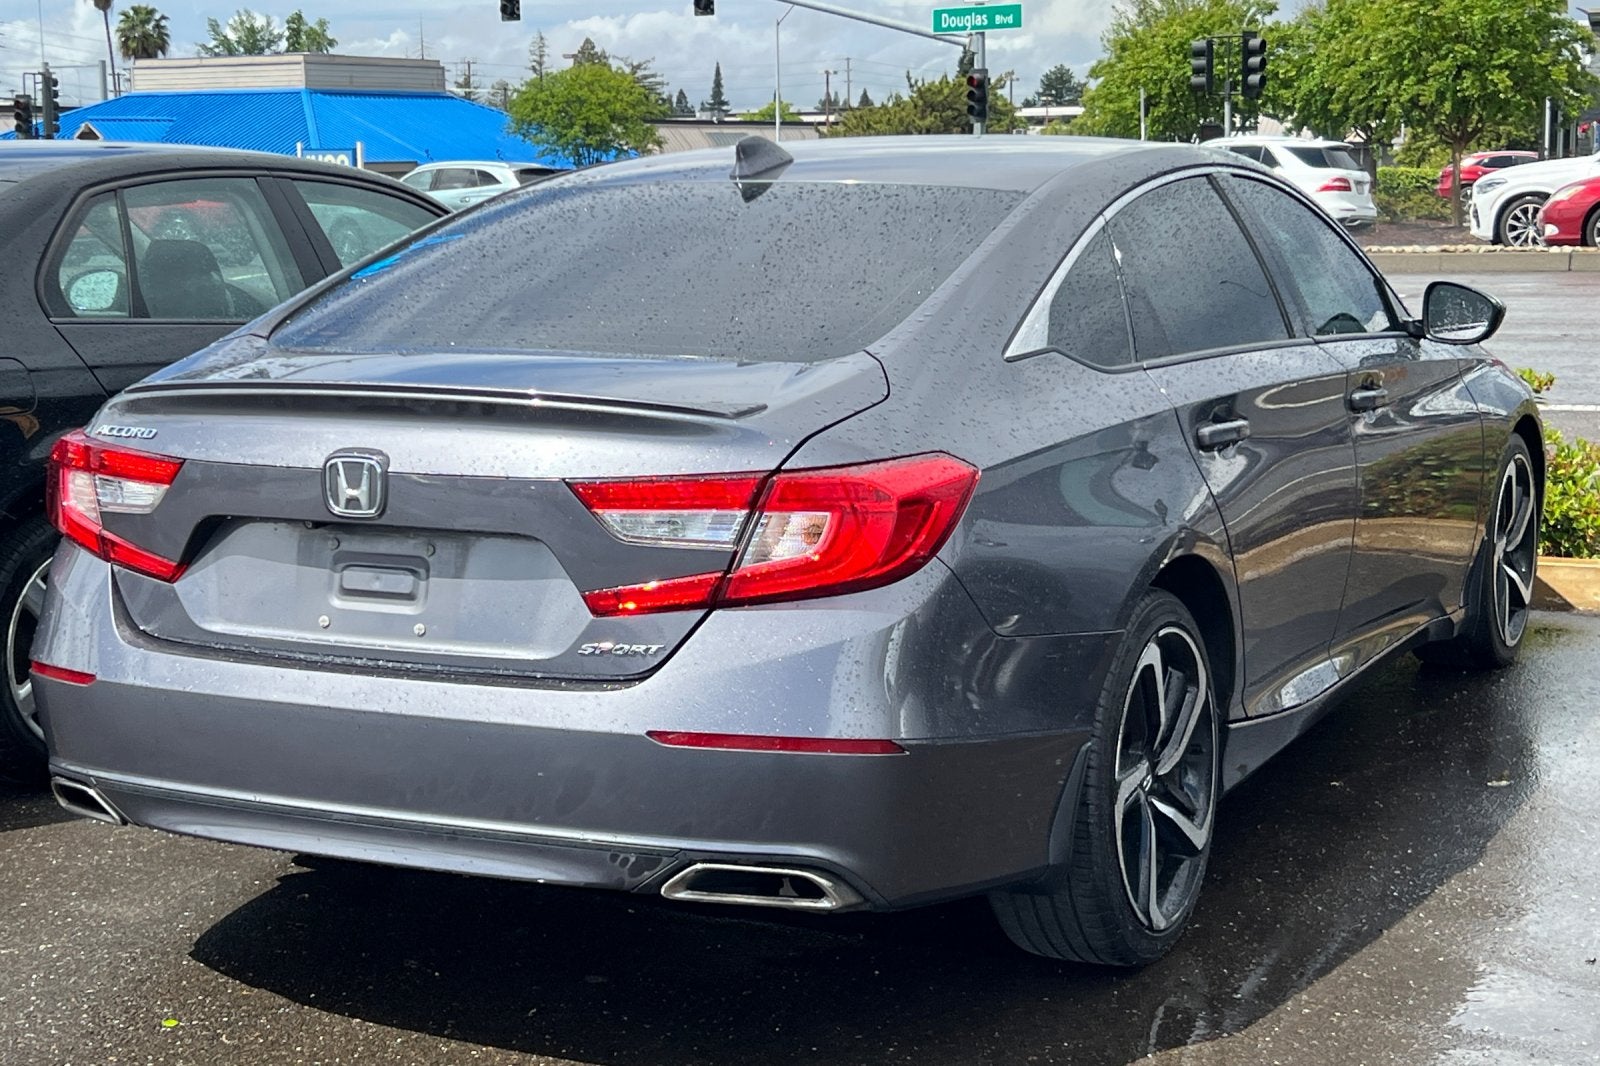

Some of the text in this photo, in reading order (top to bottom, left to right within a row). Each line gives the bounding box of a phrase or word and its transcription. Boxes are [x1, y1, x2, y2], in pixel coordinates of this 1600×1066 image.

[941, 12, 1014, 31] Douglas Blvd
[95, 424, 158, 439] ACCORD
[577, 641, 665, 655] SPORT
